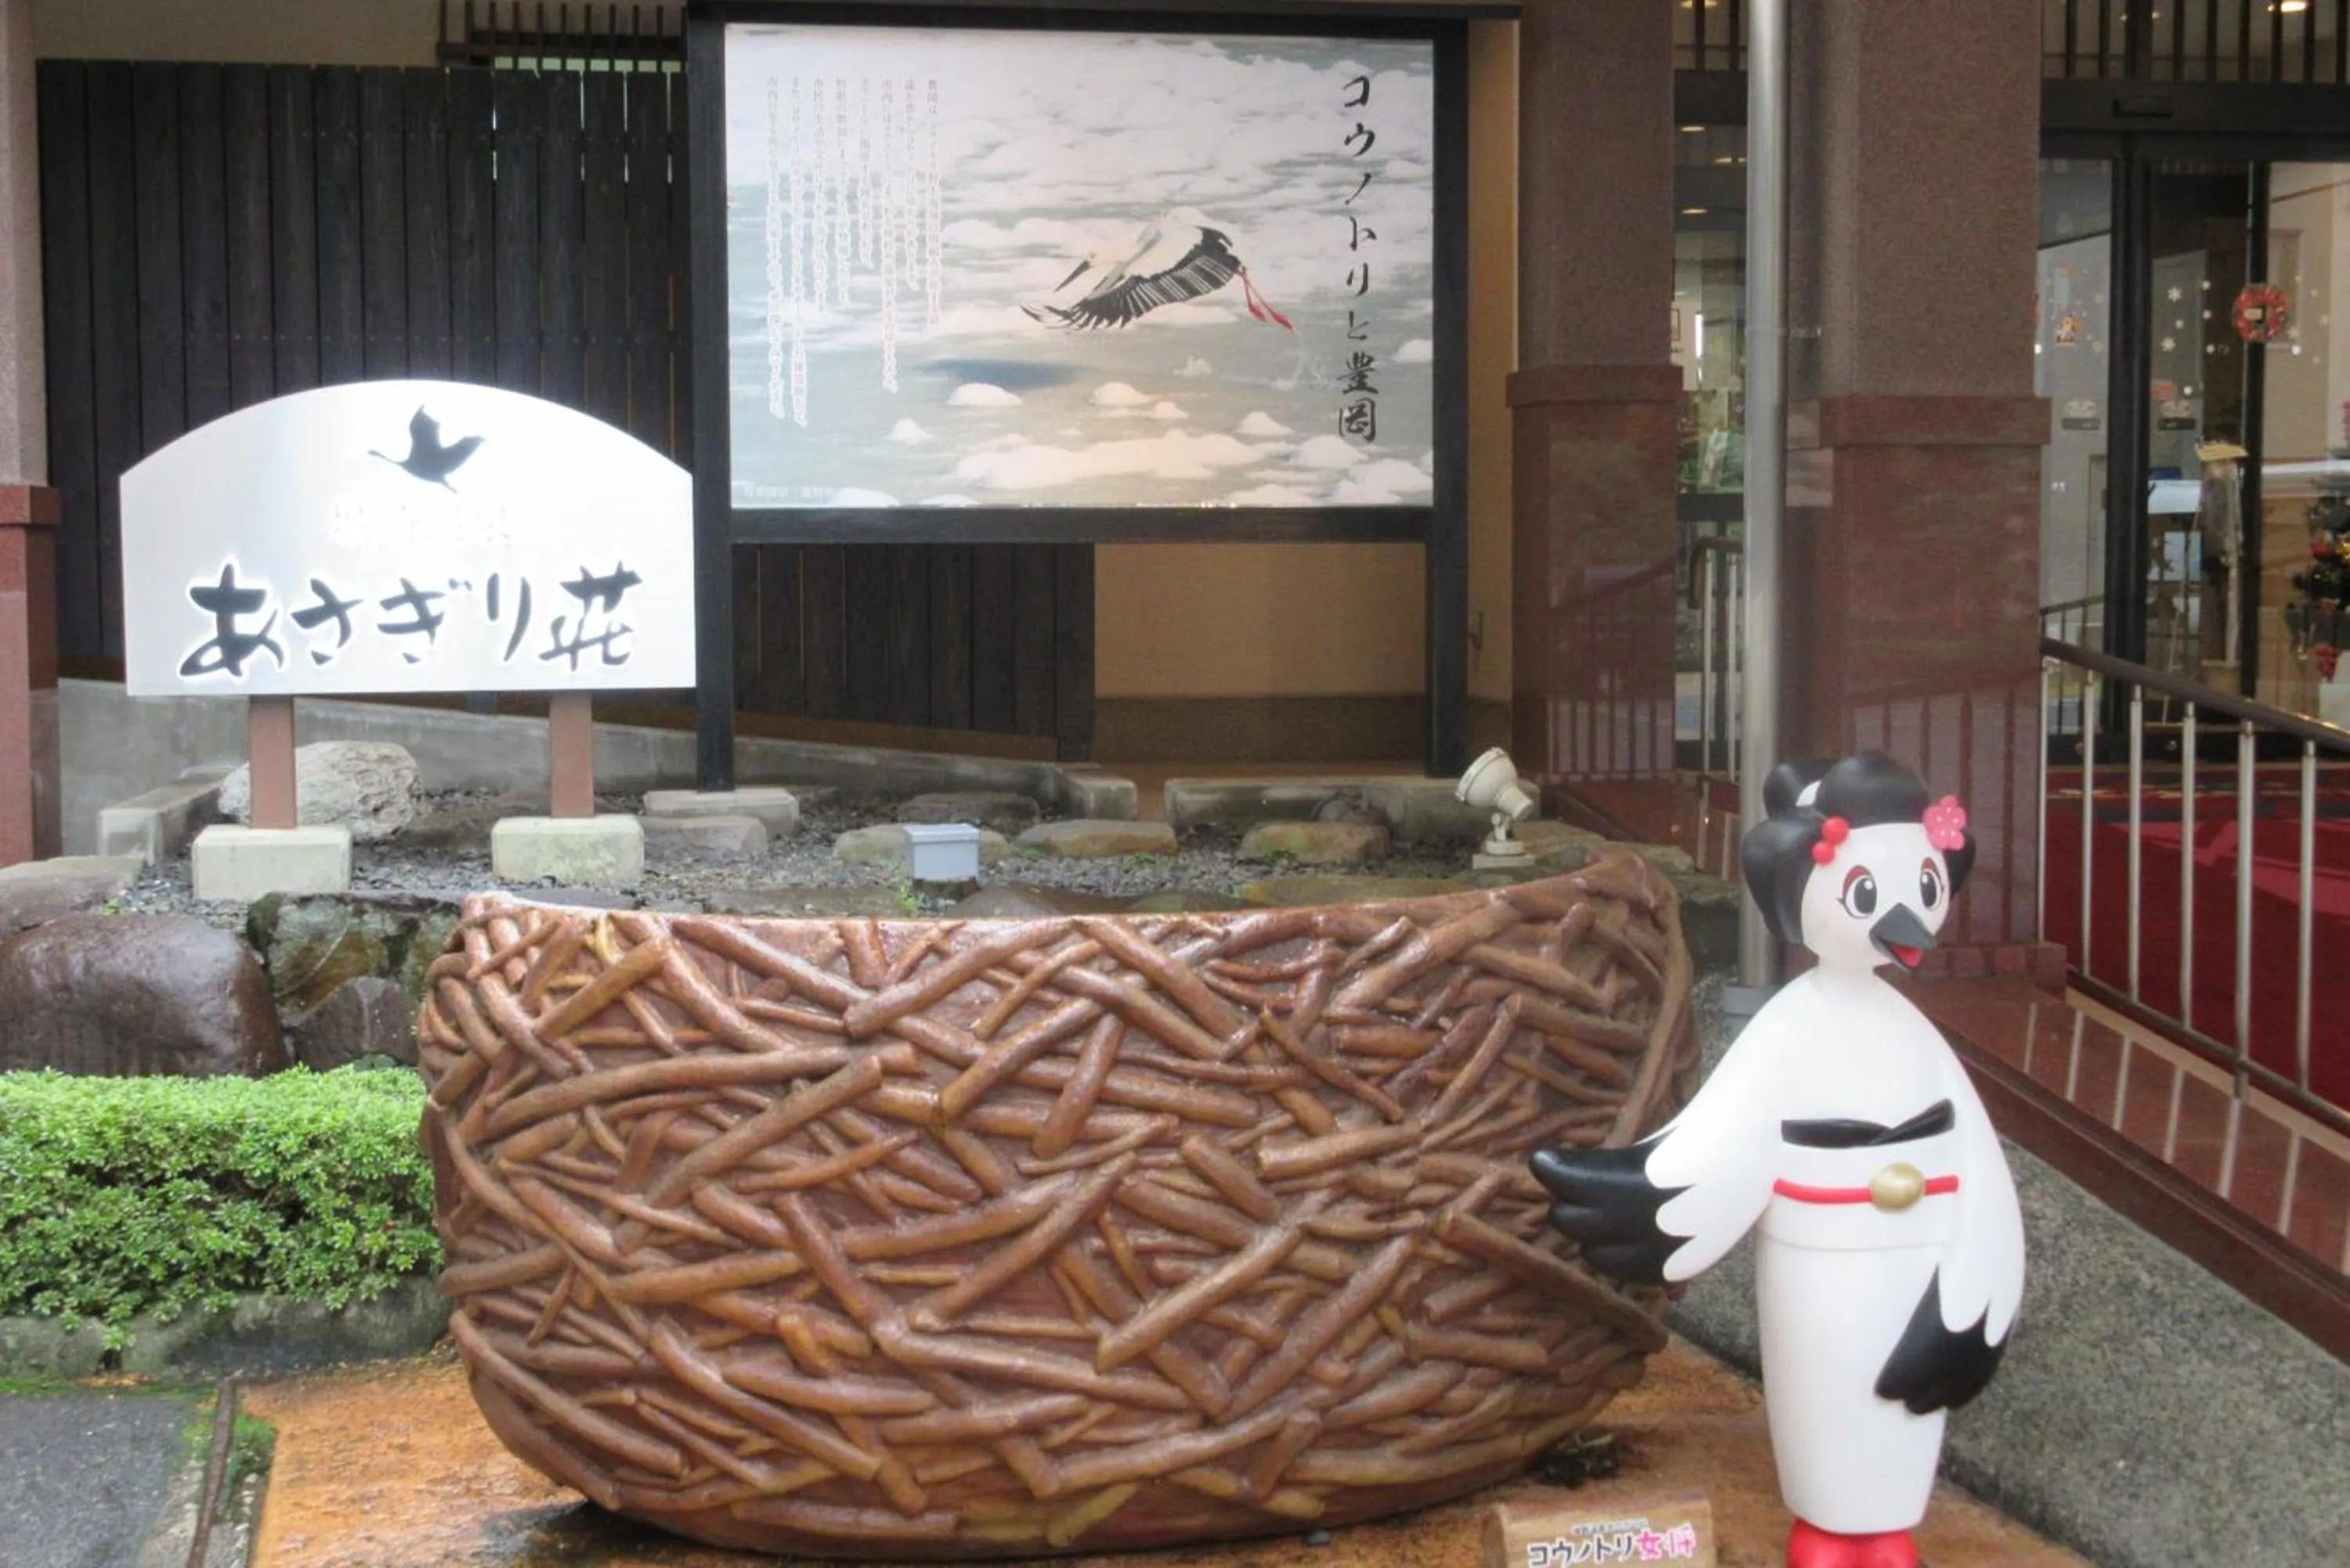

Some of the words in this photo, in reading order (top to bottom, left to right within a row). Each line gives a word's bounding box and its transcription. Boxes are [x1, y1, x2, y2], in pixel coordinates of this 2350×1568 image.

[1337, 75, 1379, 444] コウノトリと豊岡
[179, 562, 643, 678] あさぎり荘
